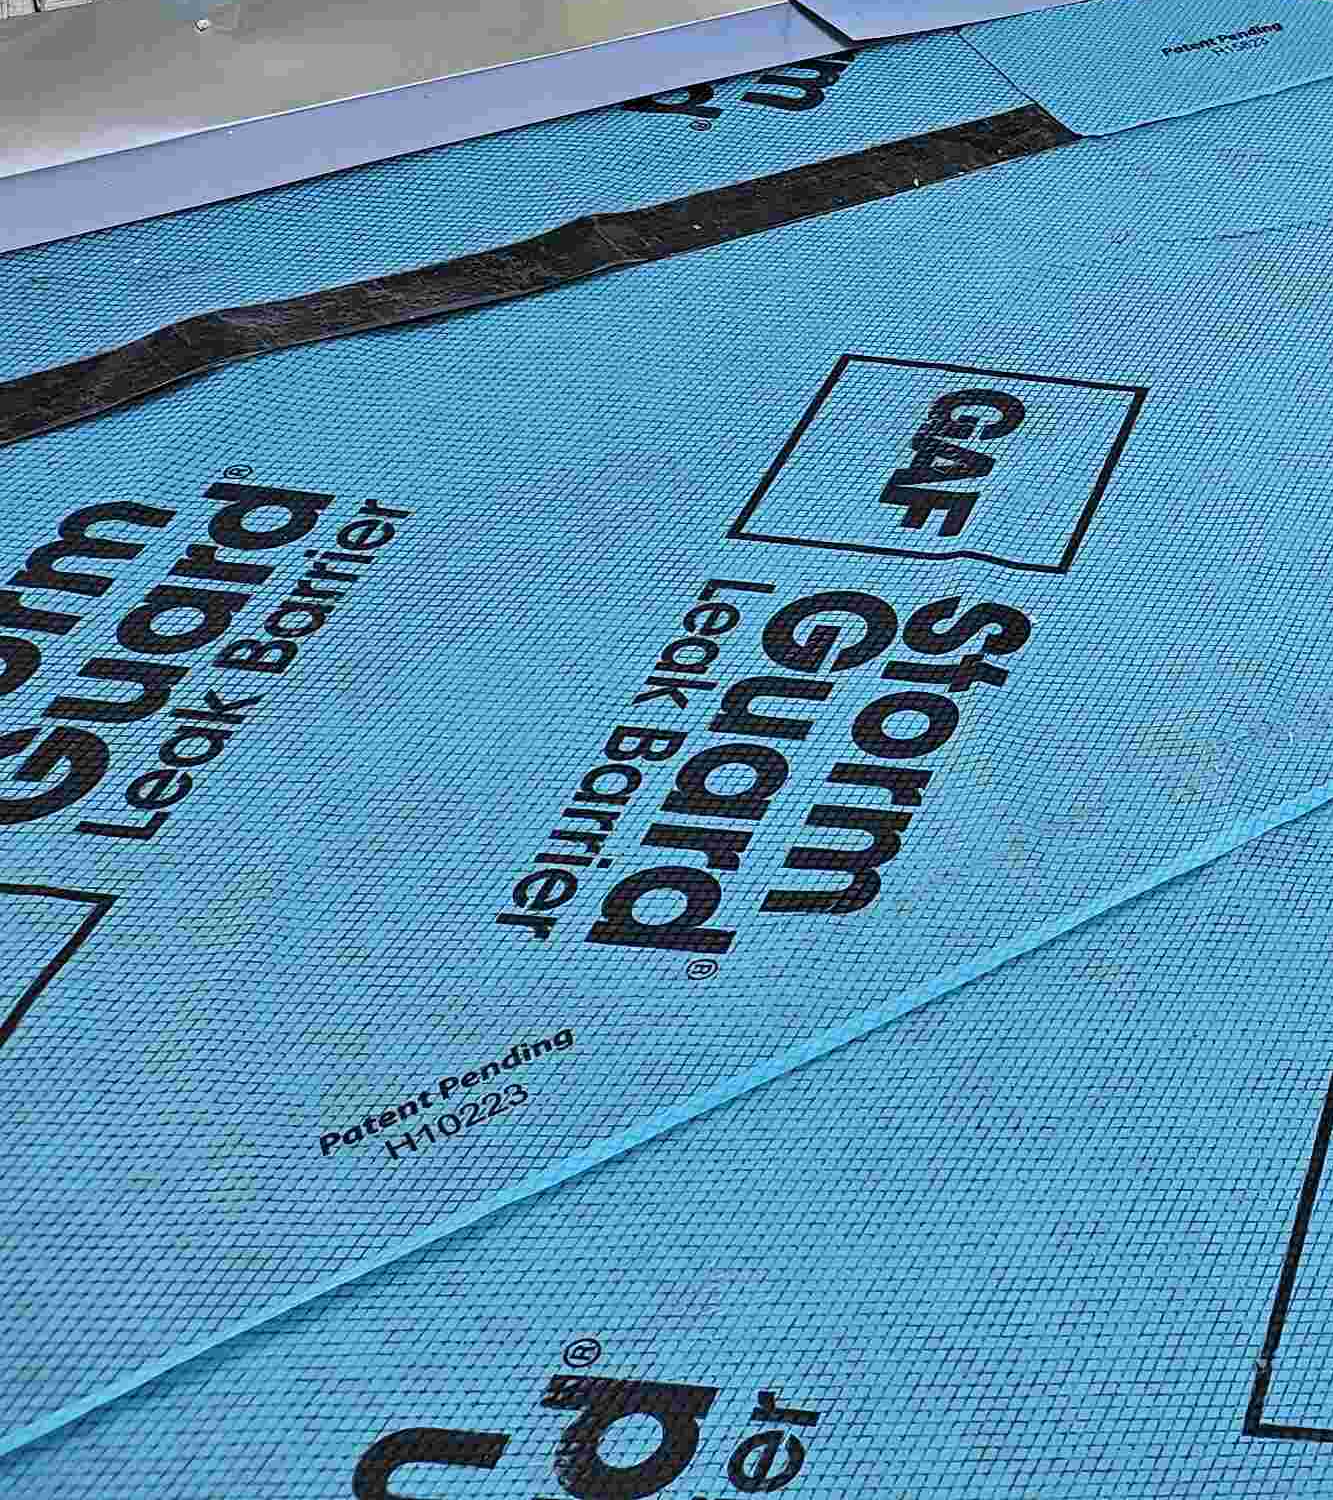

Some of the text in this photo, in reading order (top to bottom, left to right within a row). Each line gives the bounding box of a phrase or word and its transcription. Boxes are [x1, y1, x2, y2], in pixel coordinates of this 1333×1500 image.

[878, 389, 1025, 536] GAF
[75, 499, 412, 839] Leak Barrier
[496, 578, 775, 944] Leak Barrier
[758, 595, 1031, 914] Storm
[319, 1029, 576, 1156] Patent Pending
[384, 1082, 530, 1160] H10223
